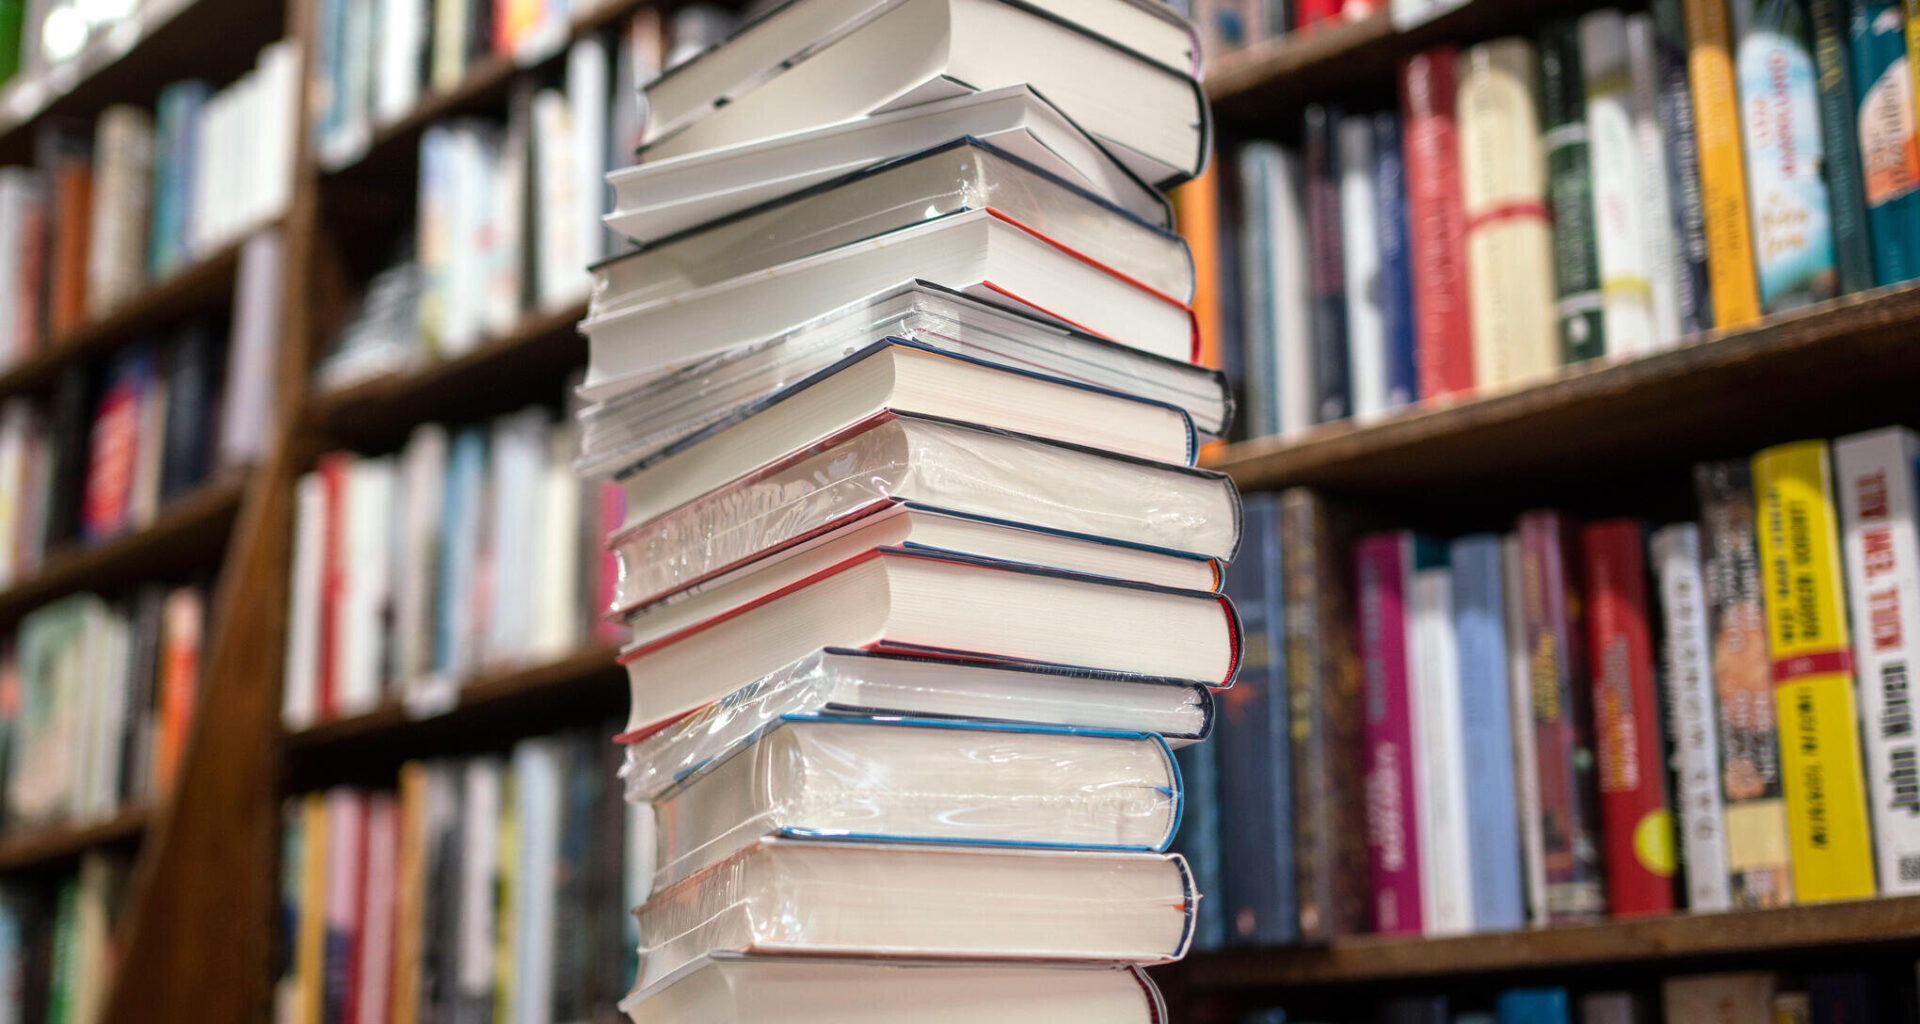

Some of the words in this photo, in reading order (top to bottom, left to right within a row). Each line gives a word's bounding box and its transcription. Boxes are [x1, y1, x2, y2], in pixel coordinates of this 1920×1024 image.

[1856, 470, 1887, 519] ALL
[1869, 588, 1903, 651] KILL
[1880, 664, 1910, 739] Niven
[1887, 749, 1920, 816] John
